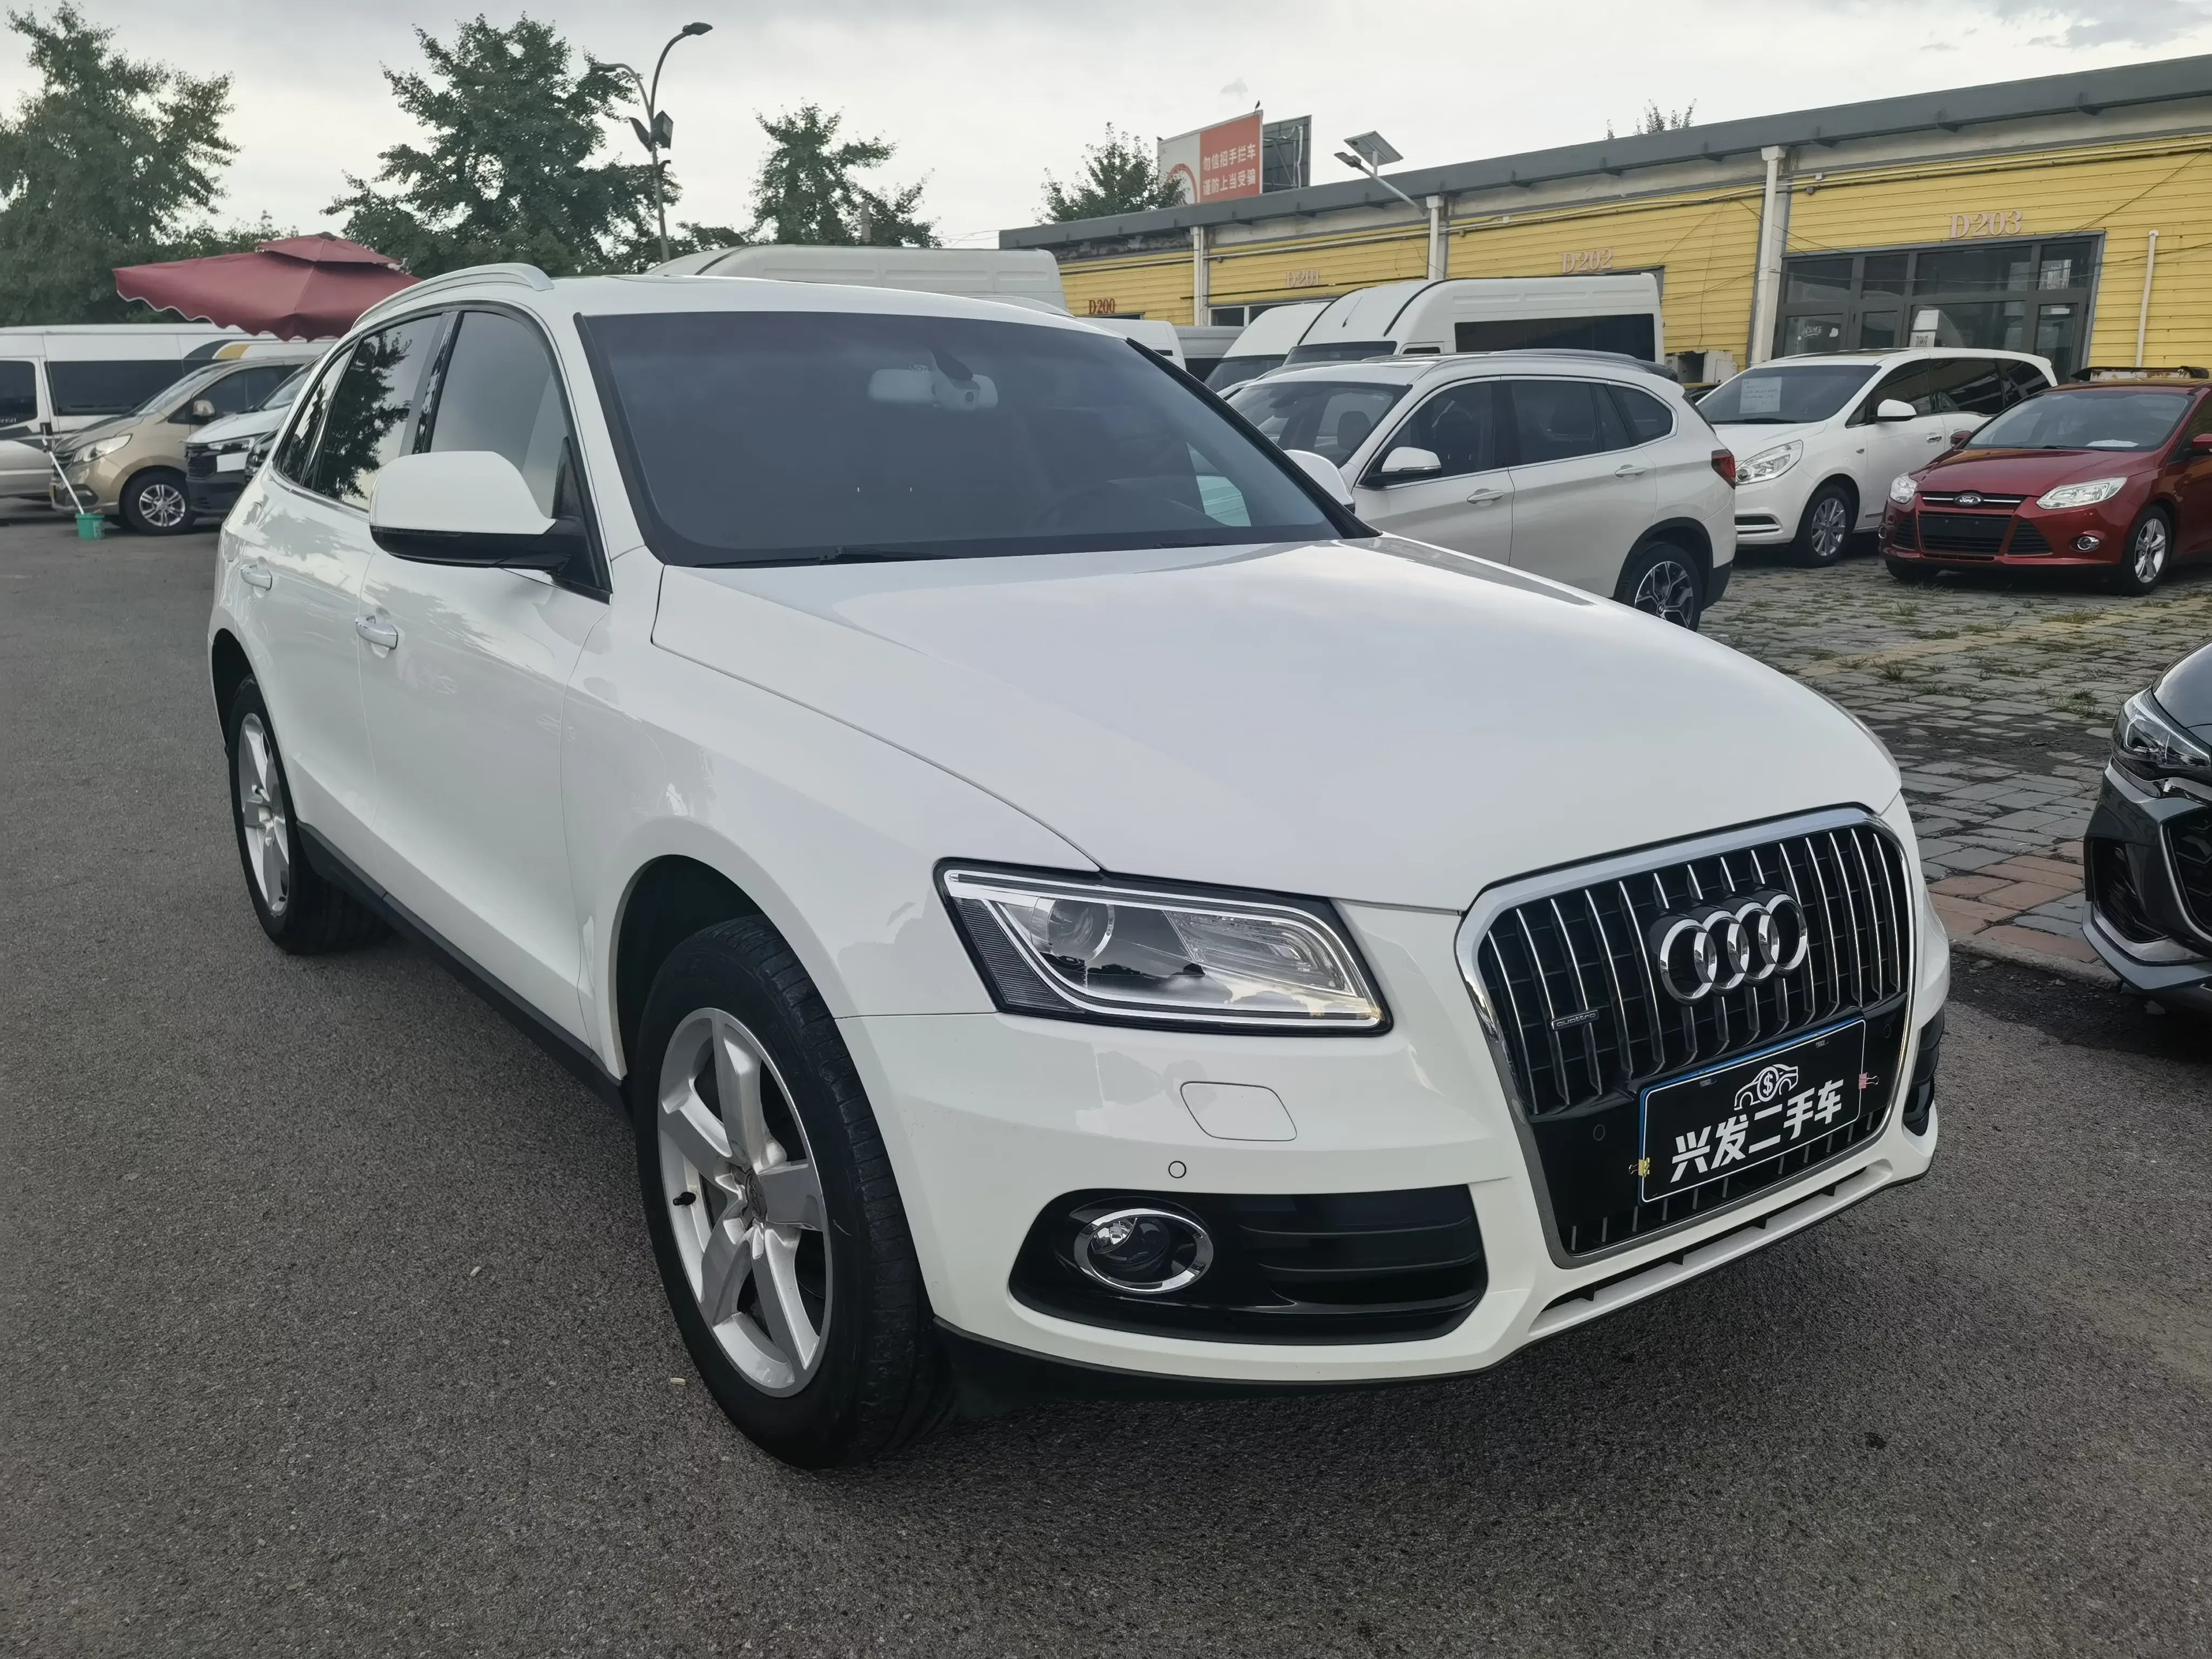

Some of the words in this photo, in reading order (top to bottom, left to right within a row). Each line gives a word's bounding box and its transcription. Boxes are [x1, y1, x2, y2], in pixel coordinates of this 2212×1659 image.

[1203, 143, 1256, 171] 勿信招手拦车
[1203, 167, 1256, 195] 谨防上当受骗
[1949, 210, 2022, 239] D203
[1562, 249, 1613, 273] D202
[1286, 269, 1320, 288] D201
[1089, 298, 1115, 314] D200
[1556, 1013, 1596, 1027] quattro
[1670, 1079, 1844, 1183] 兴发二手车
